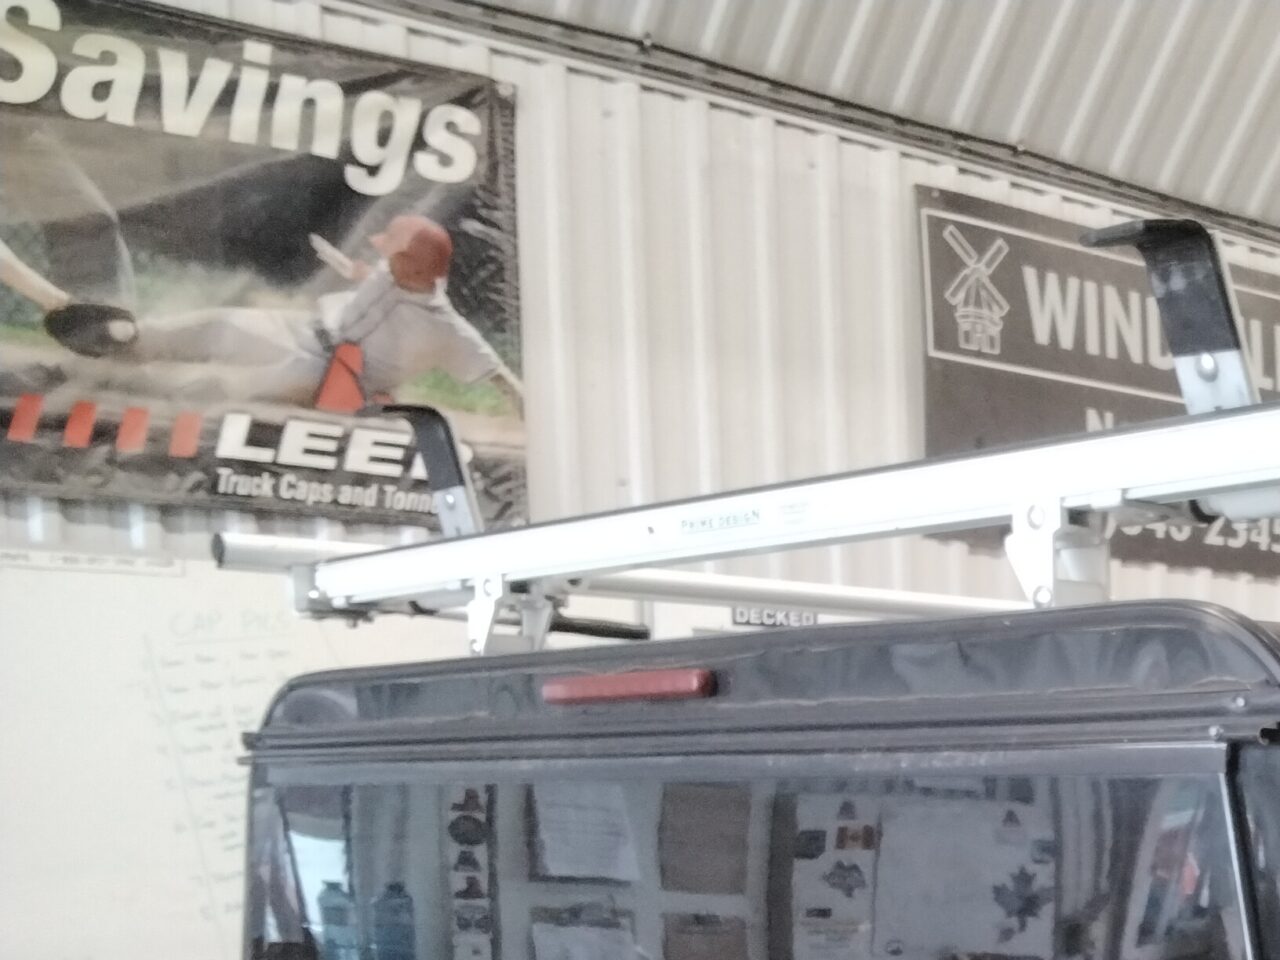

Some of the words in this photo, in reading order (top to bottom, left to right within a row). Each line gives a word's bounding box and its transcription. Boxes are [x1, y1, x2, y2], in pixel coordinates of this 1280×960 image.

[0, 0, 482, 196] Savings
[216, 467, 276, 498] Truck
[279, 473, 335, 507] Caps
[336, 482, 377, 507] and
[735, 606, 817, 626] DECKED
